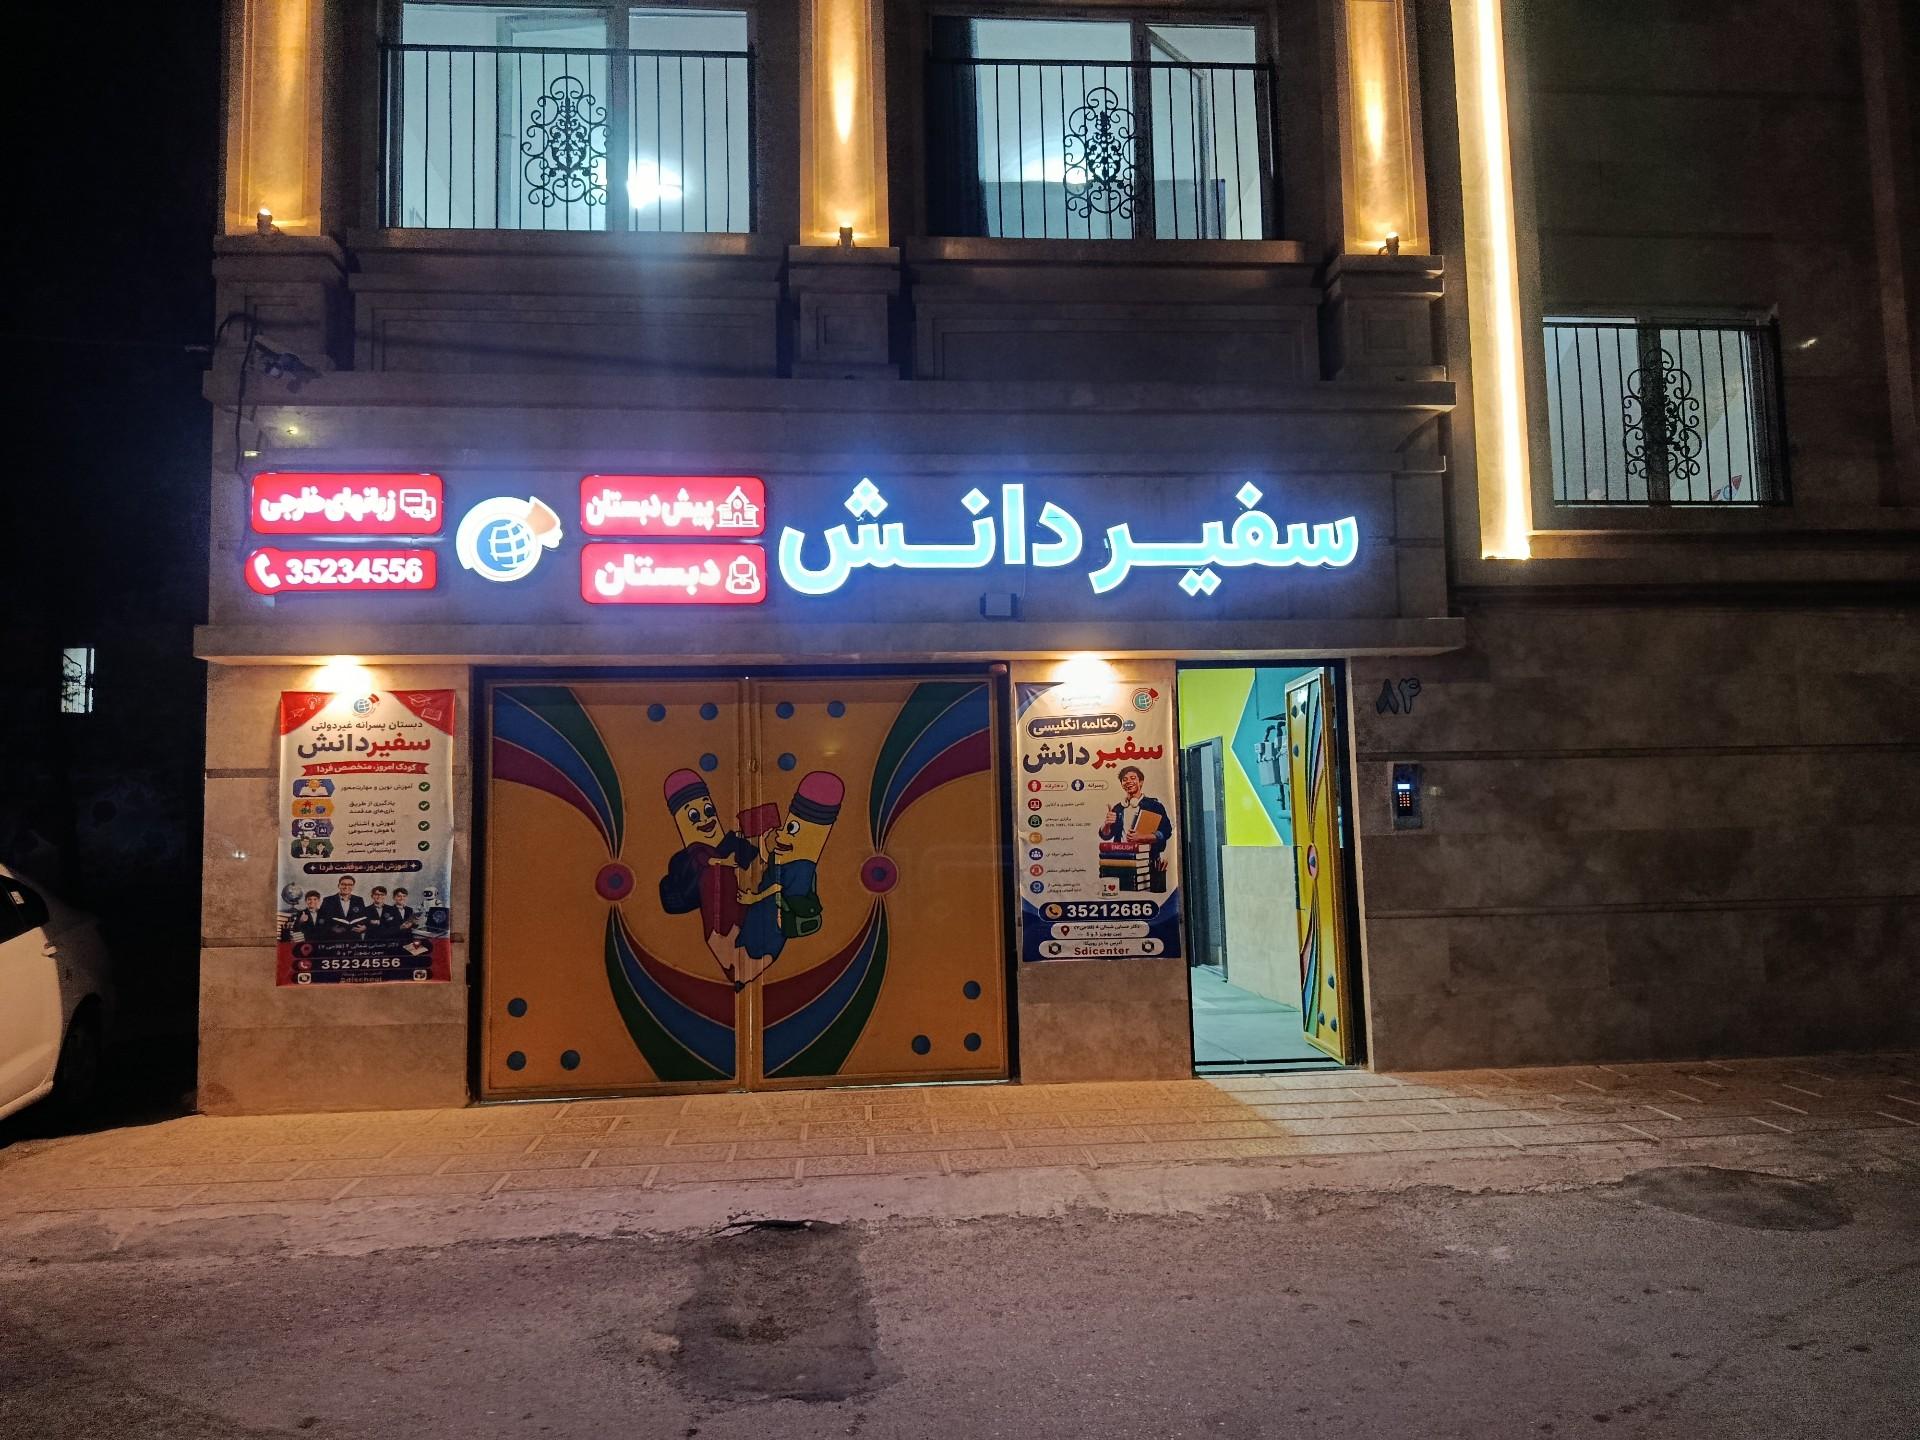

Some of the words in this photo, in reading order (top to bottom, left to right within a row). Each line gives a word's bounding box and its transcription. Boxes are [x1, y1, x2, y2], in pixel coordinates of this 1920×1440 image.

[585, 488, 662, 526] دبستان
[662, 488, 715, 531] پیش
[778, 477, 1083, 595] دانش
[1088, 481, 1359, 597] سفیر
[285, 557, 423, 585] 35234556
[594, 553, 721, 596] دبستان
[311, 721, 353, 732] غیردولتی
[355, 720, 386, 732] پسرانه
[388, 721, 423, 730] دبستان
[1032, 718, 1080, 736] انگلیسی
[1081, 717, 1119, 729] مکالمه
[297, 732, 370, 759] دانش
[366, 732, 431, 758] سفیر
[1091, 735, 1163, 770] سفیر
[1022, 741, 1090, 774] دانش
[316, 764, 333, 774] فردا
[334, 763, 373, 774] متخصص
[395, 763, 417, 771] کودک
[1066, 903, 1153, 918] 35212686
[1074, 946, 1131, 956] Sdicenter
[321, 957, 401, 970] 35234556
